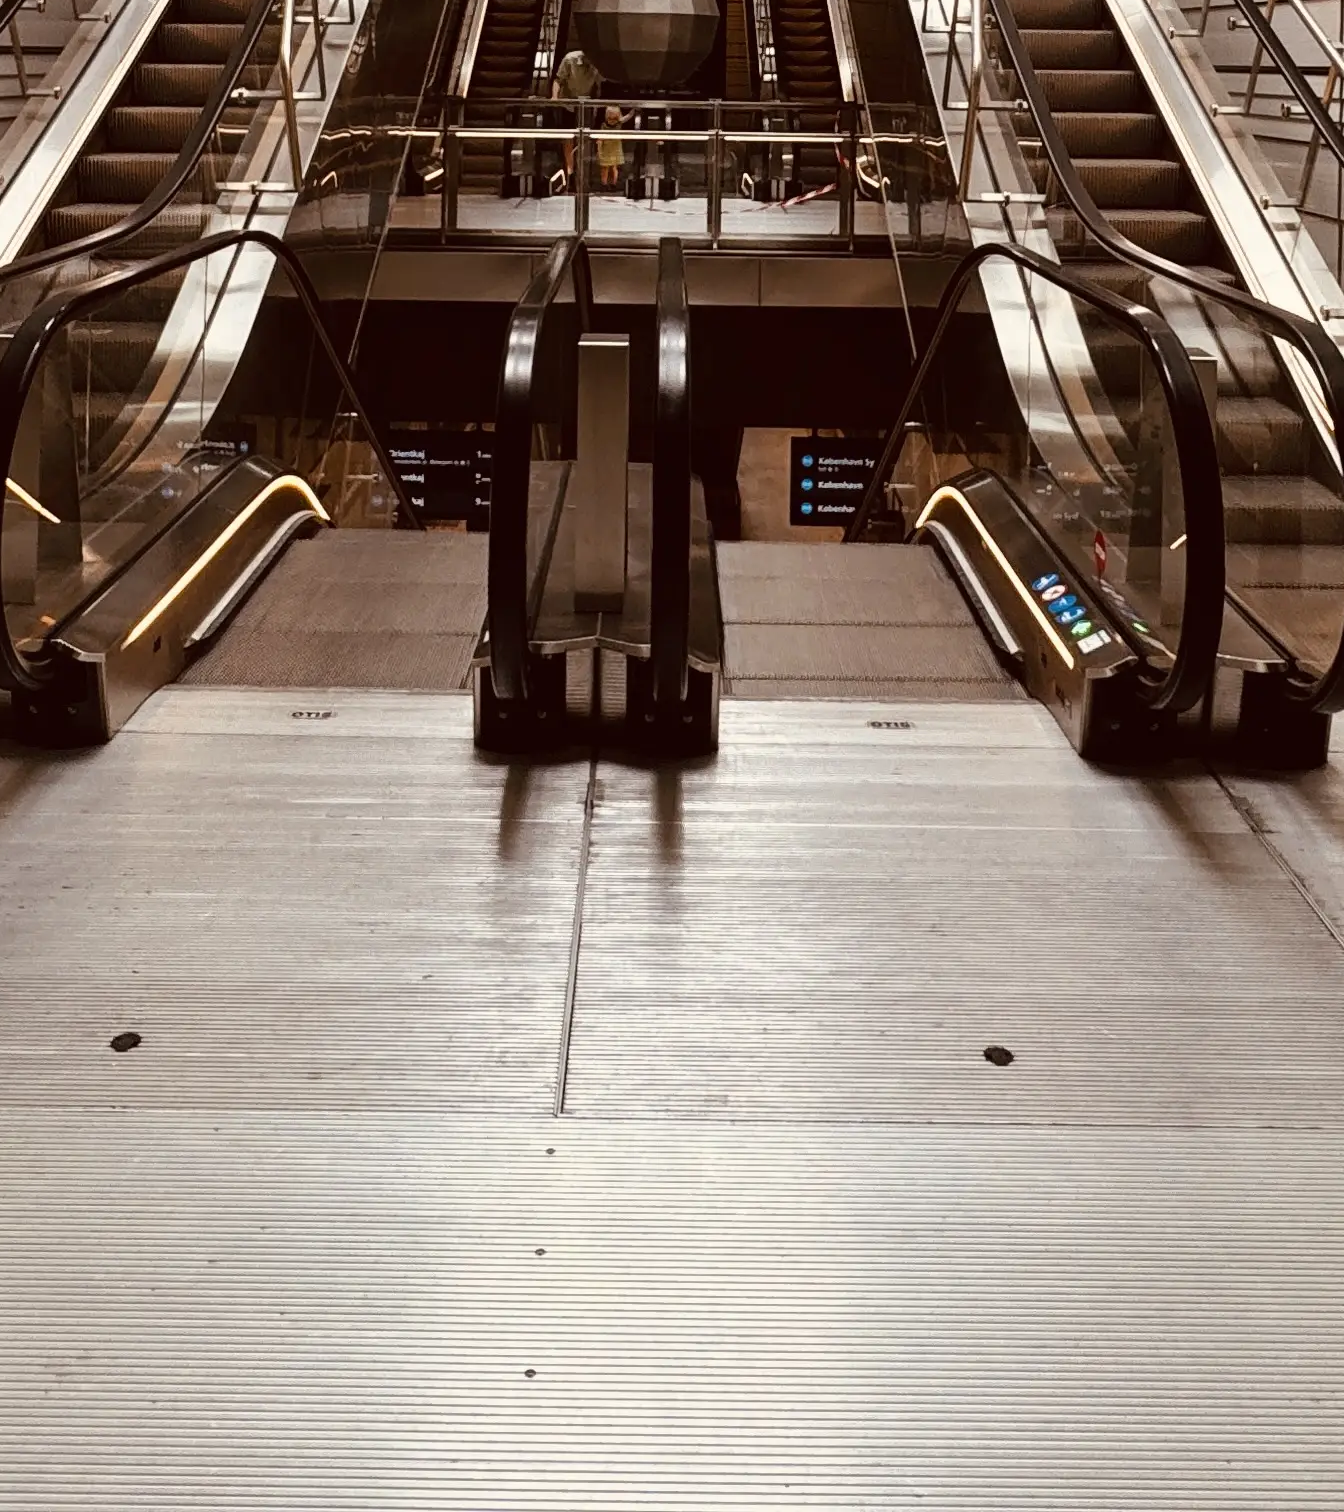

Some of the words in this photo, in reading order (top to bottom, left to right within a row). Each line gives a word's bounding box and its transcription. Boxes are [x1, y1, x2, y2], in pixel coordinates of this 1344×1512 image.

[865, 458, 875, 468] Sy
[818, 504, 855, 513] Københa
[292, 711, 332, 719] OTIS
